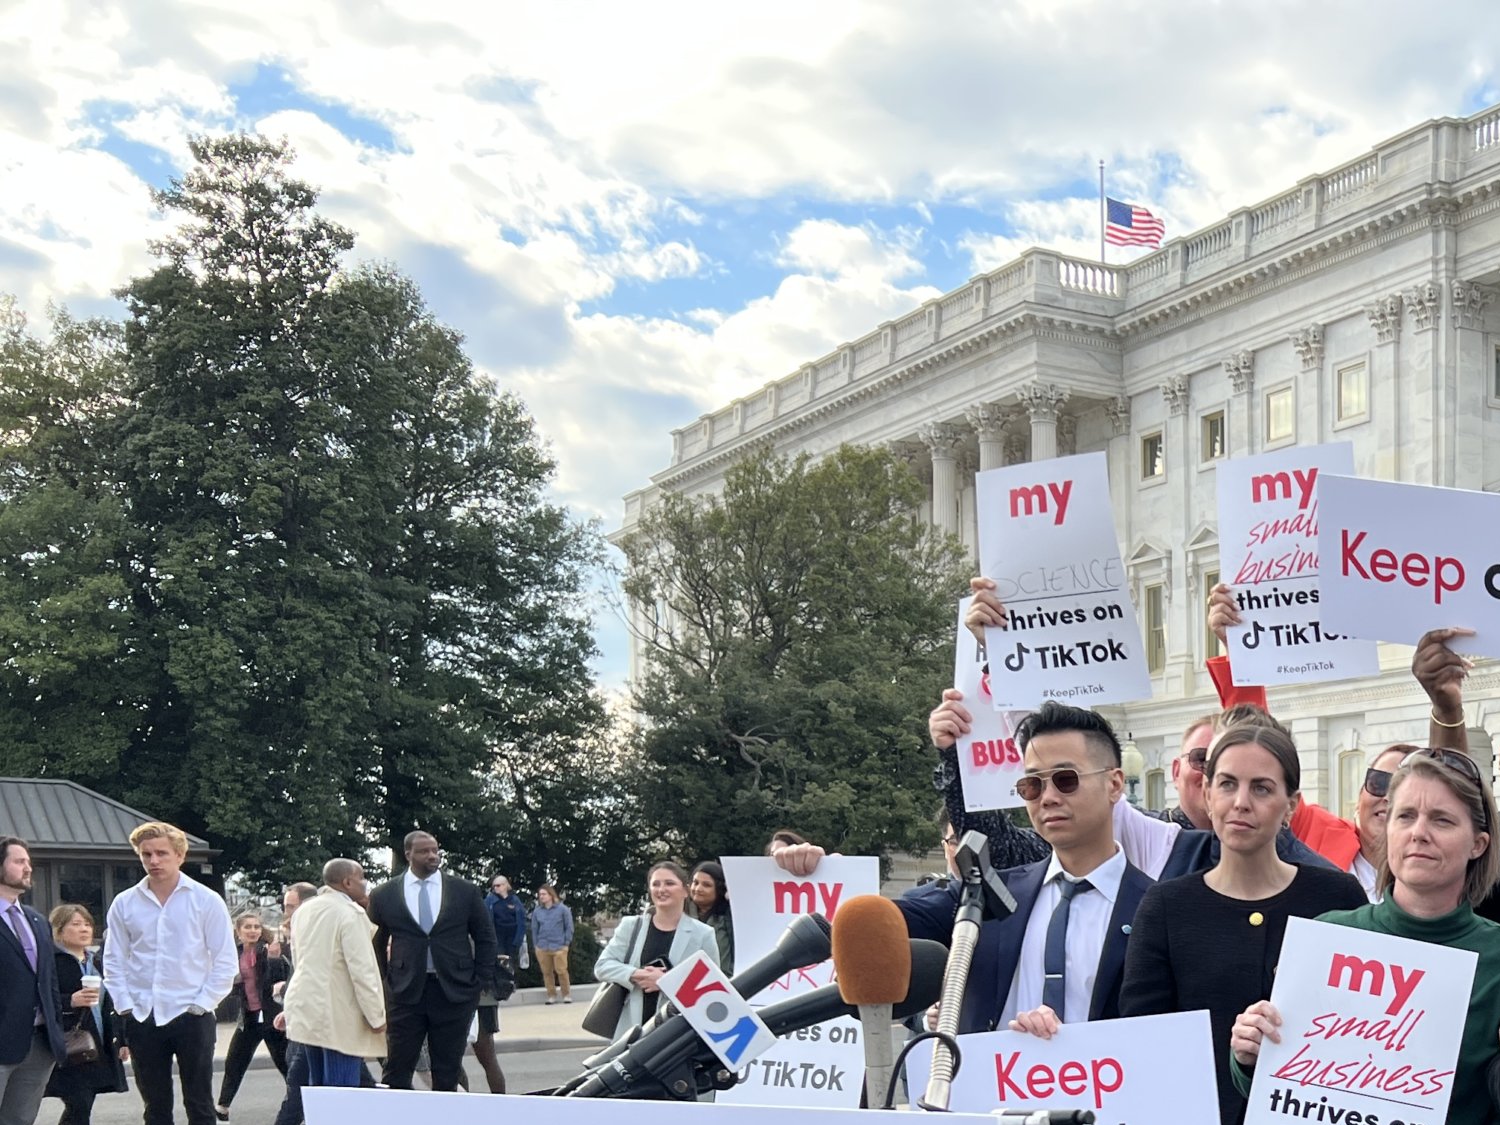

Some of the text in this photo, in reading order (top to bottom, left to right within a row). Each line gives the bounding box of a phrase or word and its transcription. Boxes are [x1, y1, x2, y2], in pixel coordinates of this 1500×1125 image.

[1009, 479, 1073, 526] my
[1251, 468, 1318, 510] my
[1341, 530, 1465, 604] Keep
[1093, 604, 1124, 621] on
[1236, 588, 1319, 611] thrives
[1270, 621, 1357, 647] TikT
[1034, 638, 1128, 669] TikTok
[1276, 661, 1335, 675] #KeepTikTok
[1042, 684, 1105, 698] #KeepTikTok
[773, 881, 843, 922] my
[1327, 953, 1426, 1016] my
[829, 1026, 858, 1044] on
[1303, 1009, 1425, 1051] small
[761, 1060, 846, 1091] TikTok
[994, 1051, 1124, 1109] Keep
[1274, 1044, 1455, 1096] business
